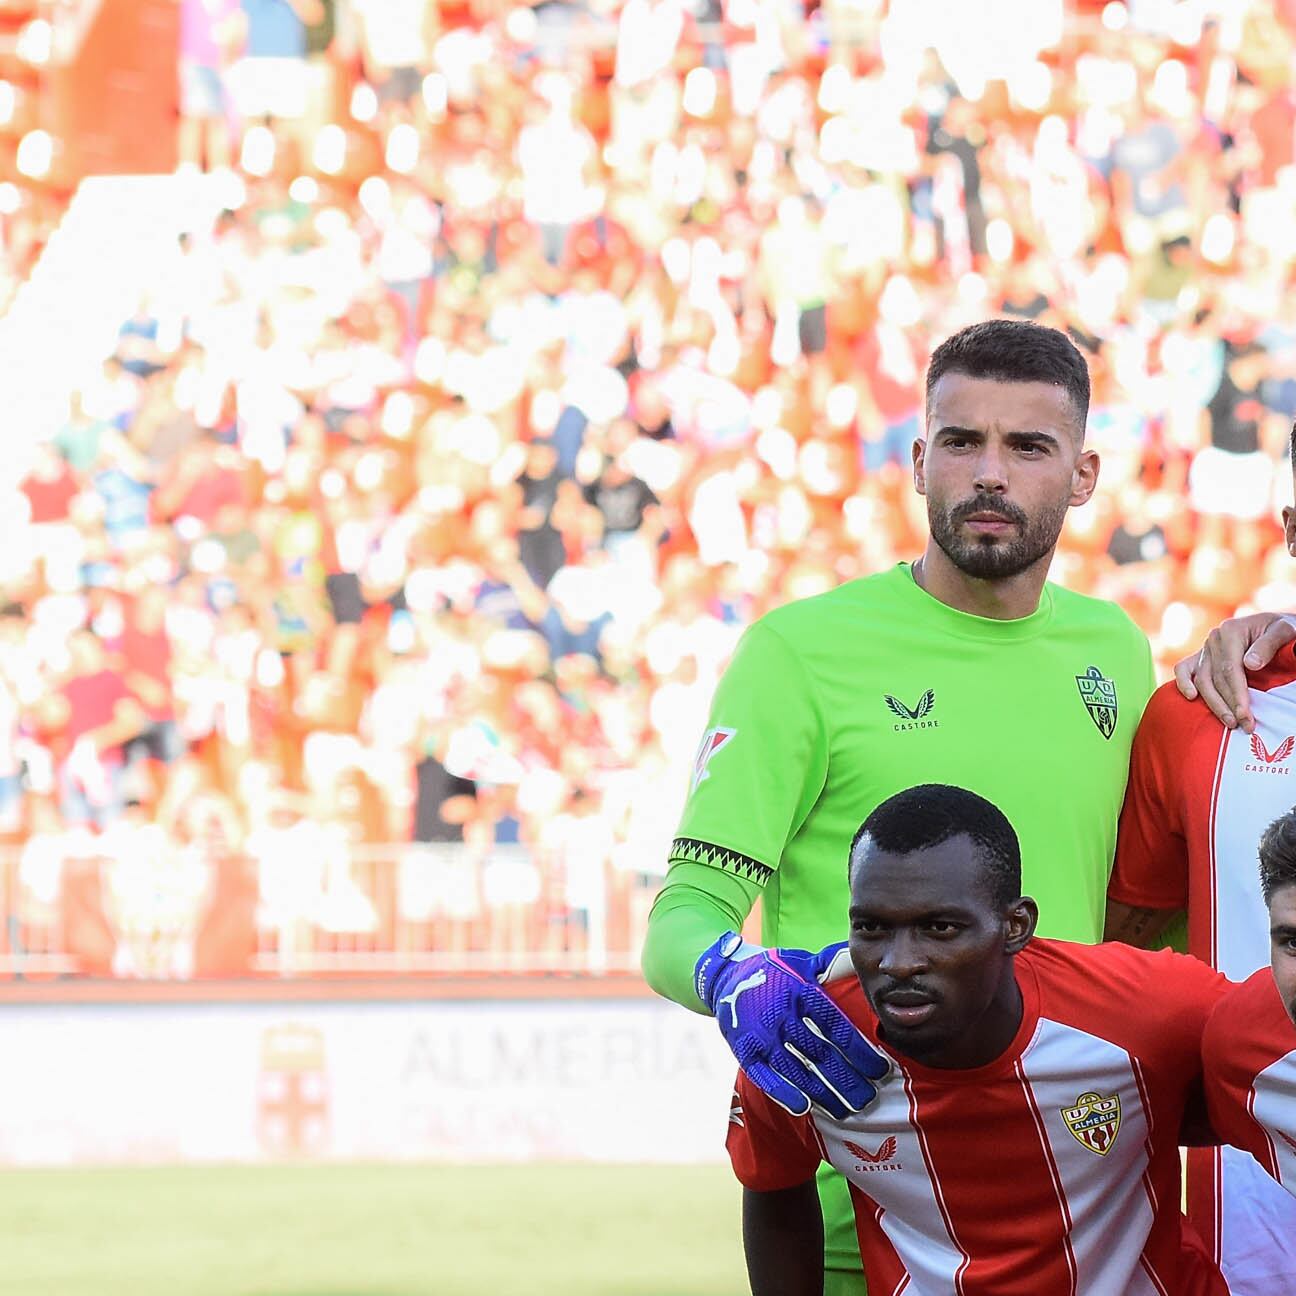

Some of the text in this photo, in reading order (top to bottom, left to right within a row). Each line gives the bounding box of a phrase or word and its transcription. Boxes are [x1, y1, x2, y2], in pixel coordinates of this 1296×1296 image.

[1086, 695, 1115, 704] ALMERIA
[894, 720, 939, 732] CASTORE
[1245, 764, 1289, 775] CASTORE
[1073, 1112, 1116, 1130] ALMERIA
[855, 1164, 902, 1172] CASTORE
